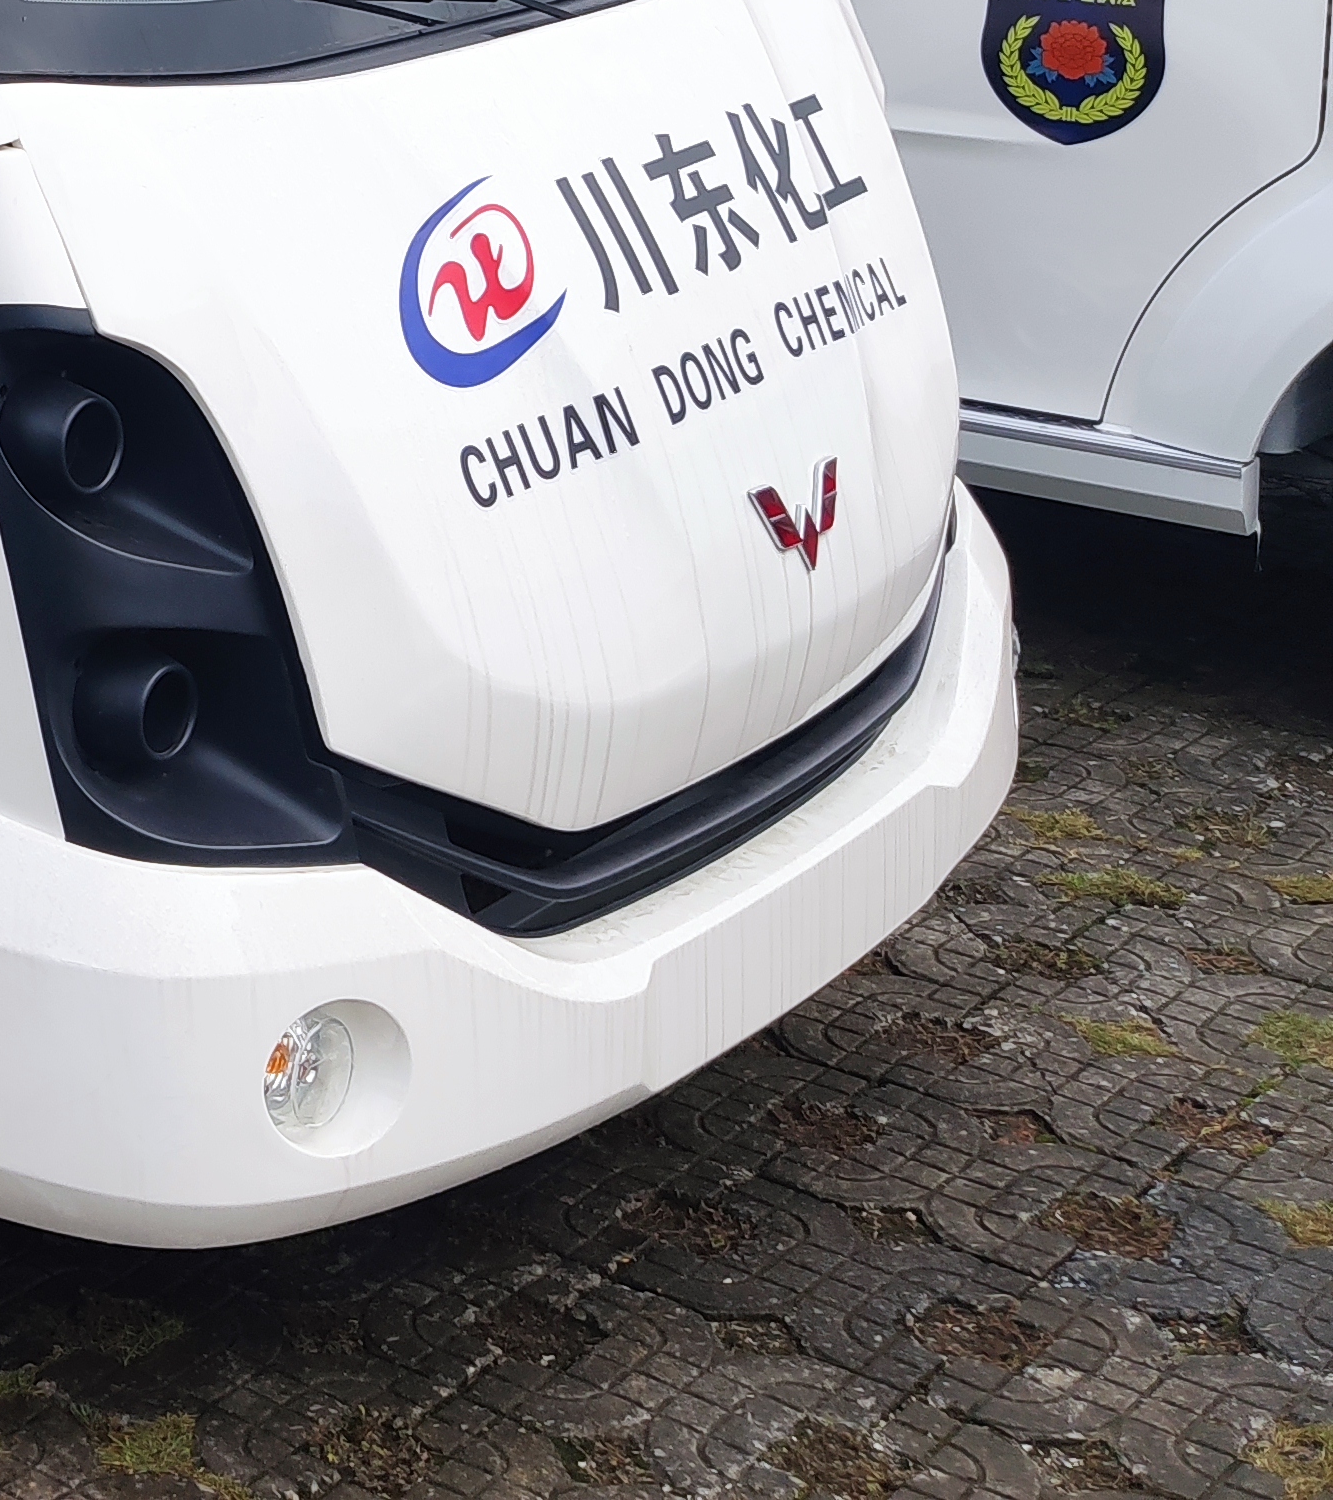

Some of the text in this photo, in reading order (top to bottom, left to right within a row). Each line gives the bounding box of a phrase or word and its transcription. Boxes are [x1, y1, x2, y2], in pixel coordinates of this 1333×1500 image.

[556, 94, 868, 312] 川东化工
[460, 257, 908, 508] CHUAN DONG CHEMICAL
